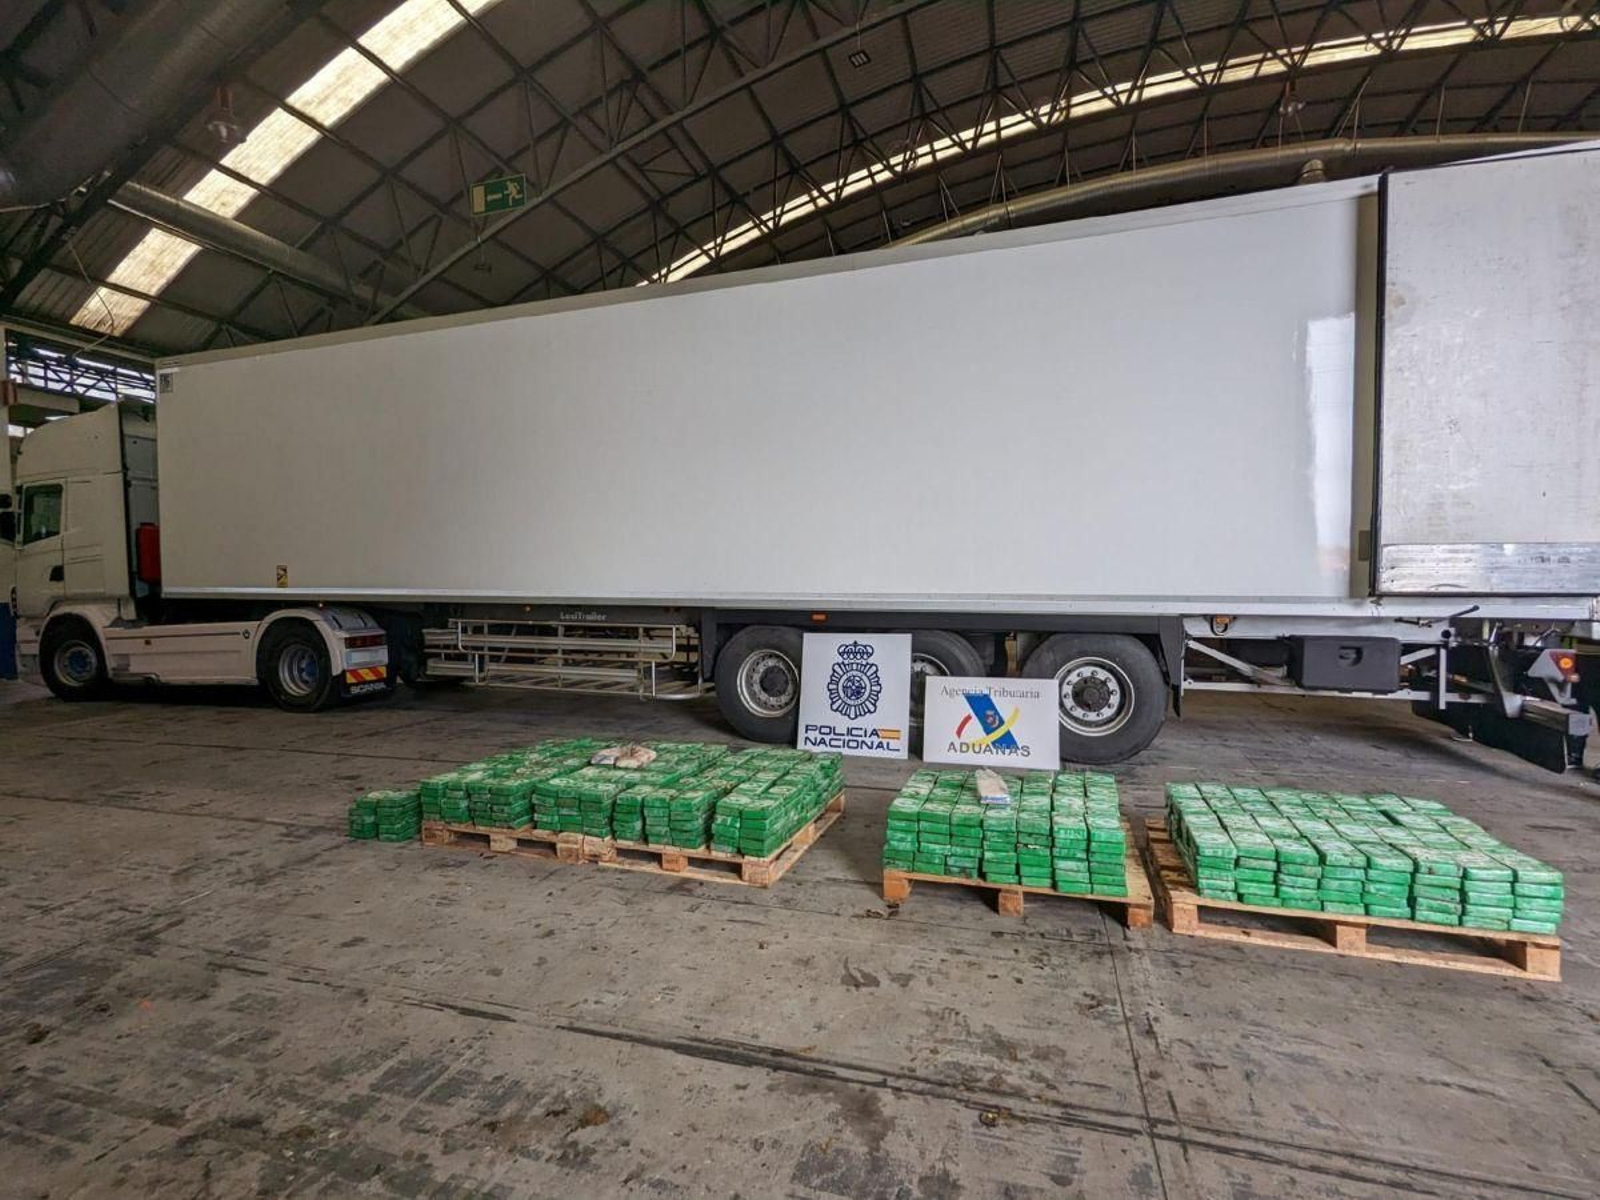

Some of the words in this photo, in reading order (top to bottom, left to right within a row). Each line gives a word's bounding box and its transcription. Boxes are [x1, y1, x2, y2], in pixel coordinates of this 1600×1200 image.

[940, 685, 984, 699] Agencia
[986, 686, 1040, 699] Tributaria
[804, 737, 900, 751] NACIONAL
[948, 741, 1031, 758] ADUANAS
